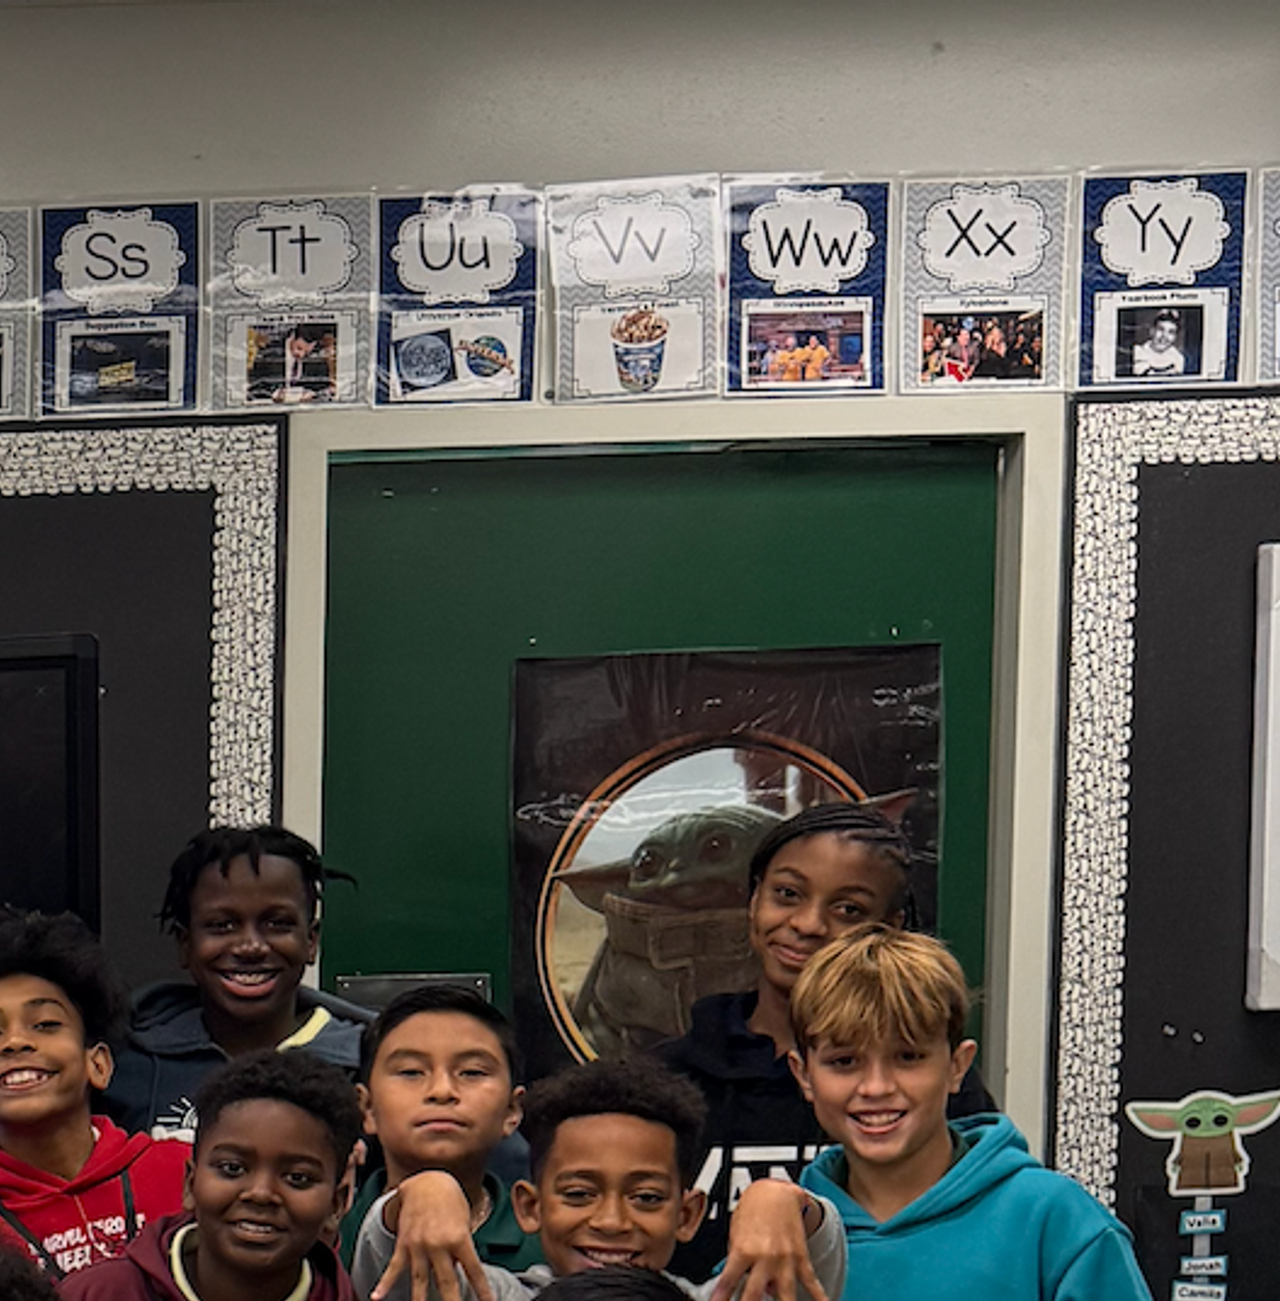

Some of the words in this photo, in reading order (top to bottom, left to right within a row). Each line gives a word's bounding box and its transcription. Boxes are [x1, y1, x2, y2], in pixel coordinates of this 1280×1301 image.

[83, 231, 151, 281] Ss
[257, 225, 322, 275] Tt
[417, 222, 491, 271] Uu
[592, 215, 666, 265] Vv
[762, 218, 858, 269] Ww
[945, 209, 1017, 257] Xx
[1127, 203, 1194, 265] Yy
[416, 312, 461, 321] Universal
[959, 299, 1009, 309] Xylophone
[1122, 293, 1167, 302] Yearbook
[1170, 292, 1199, 300] Photo
[85, 322, 136, 331] Suggestion
[139, 320, 157, 328] Box
[1177, 1286, 1222, 1299] Camila
